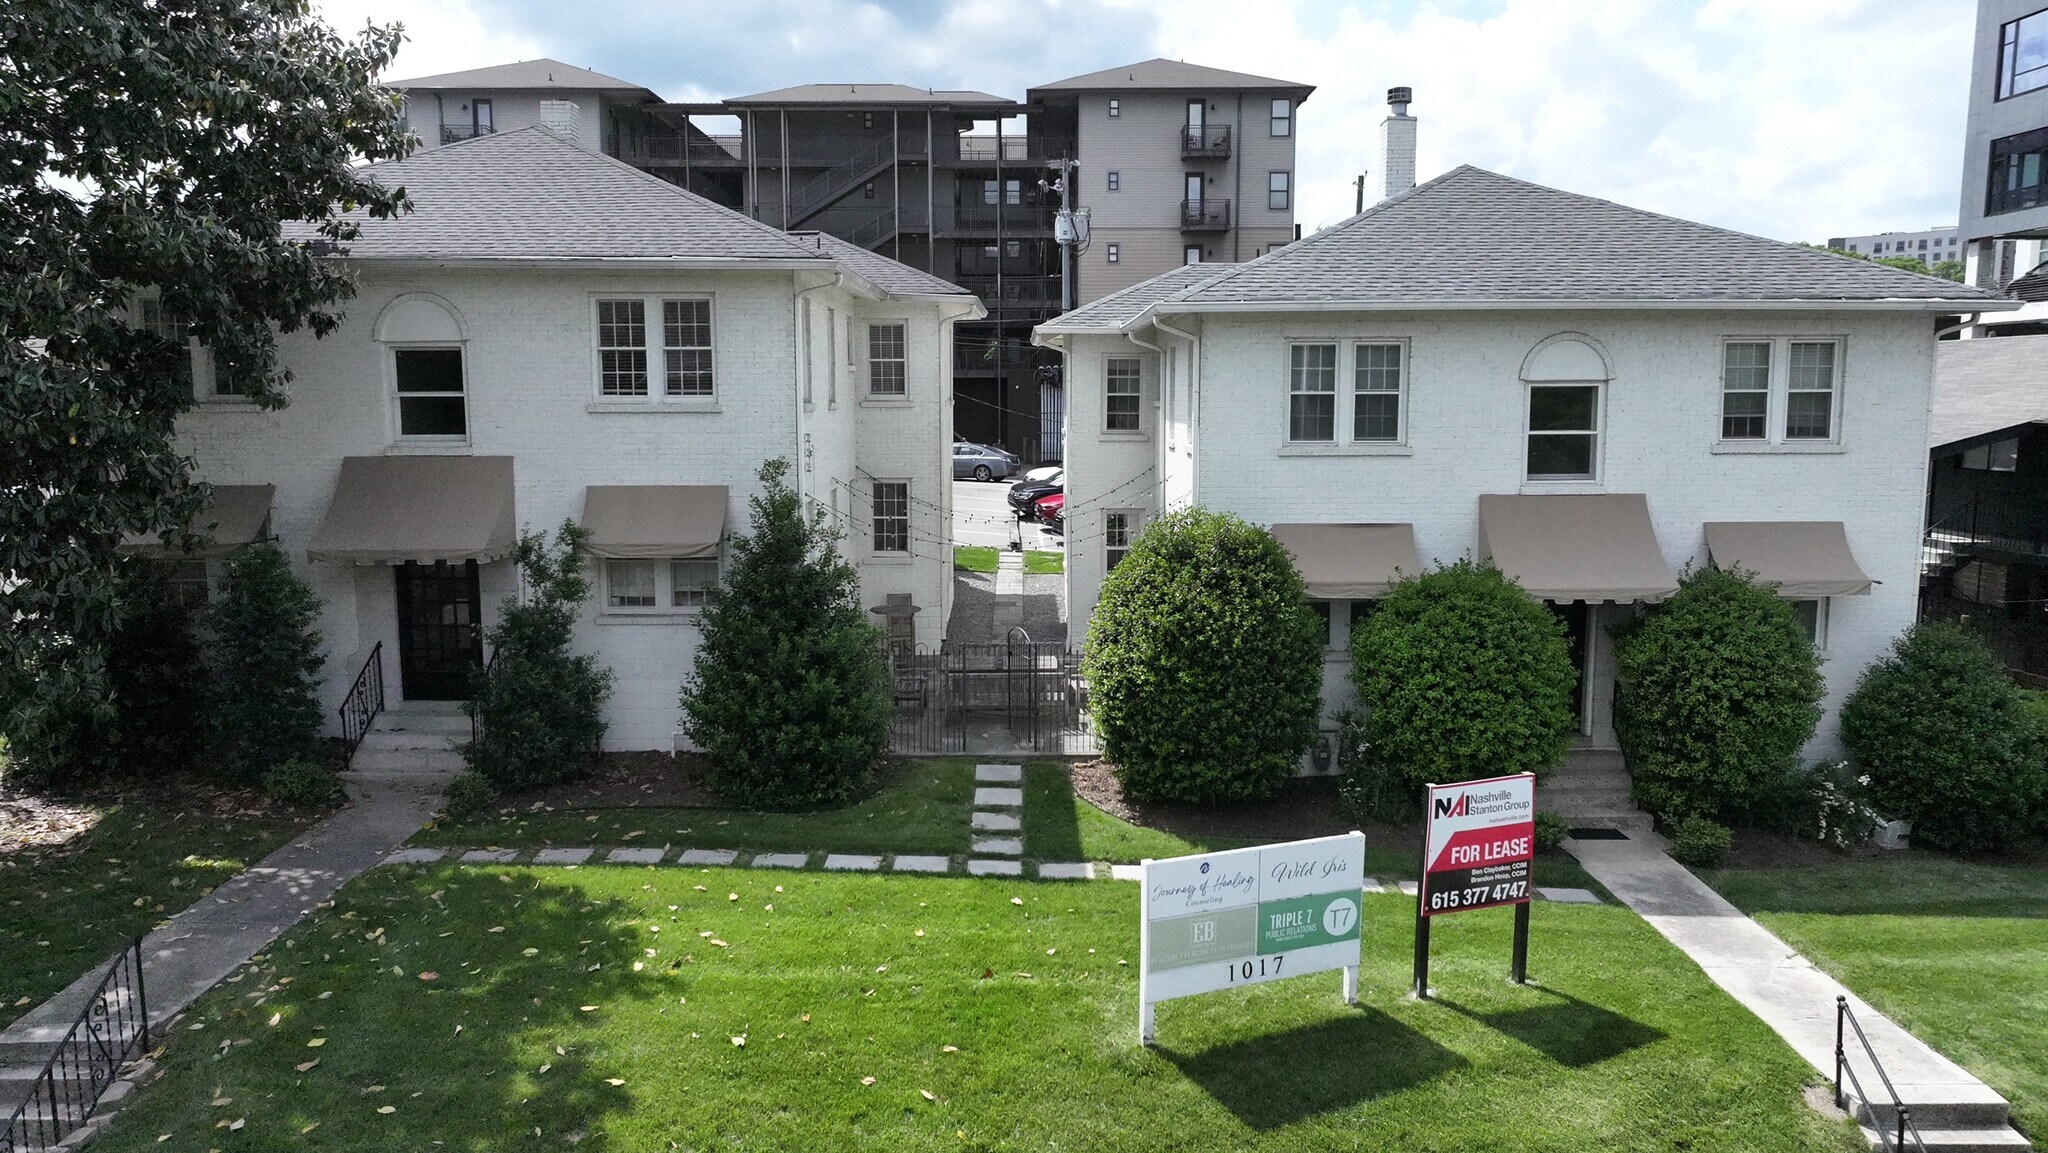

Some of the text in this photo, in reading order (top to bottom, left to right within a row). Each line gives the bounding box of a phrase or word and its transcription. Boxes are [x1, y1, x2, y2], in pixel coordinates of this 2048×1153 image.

[1434, 790, 1470, 819] NAI
[1469, 800, 1530, 816] Stanton Group
[1470, 790, 1512, 805] Nashville
[1451, 837, 1528, 864] FOR LEASE
[1271, 855, 1347, 883] Wild Iris
[1511, 861, 1528, 869] CCIM
[1152, 872, 1256, 902] Journey of Healing
[1470, 875, 1494, 884] Brandon
[1511, 869, 1527, 877] CCIM
[1185, 896, 1223, 907] Counseling
[1431, 881, 1527, 909] 615 377 4747
[1270, 909, 1313, 930] TRIPLE 7
[1330, 907, 1351, 928] T7
[1192, 920, 1214, 943] EB
[1265, 929, 1286, 939] PUBLIC
[1286, 923, 1317, 936] RELATIONS
[1229, 956, 1283, 982] 1017
